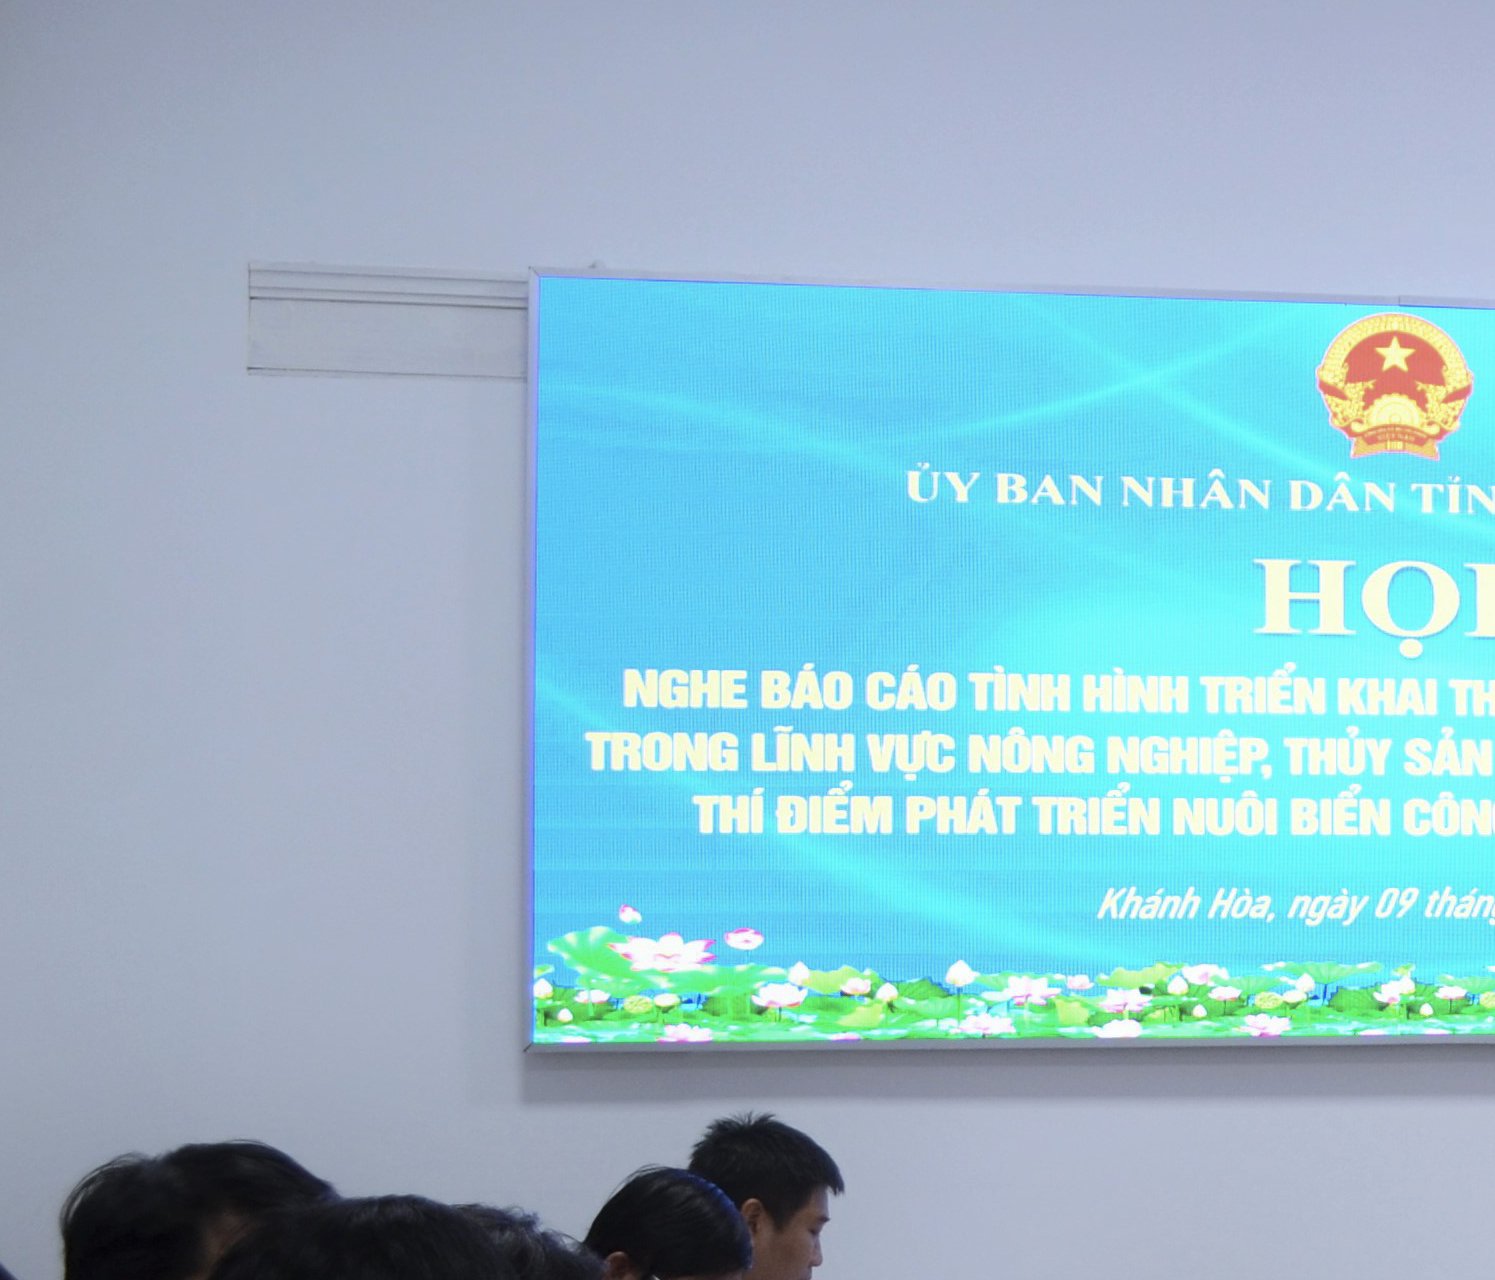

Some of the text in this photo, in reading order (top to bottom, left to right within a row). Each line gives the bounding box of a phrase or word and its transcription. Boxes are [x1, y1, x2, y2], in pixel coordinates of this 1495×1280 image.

[907, 462, 980, 503] ỦY
[996, 473, 1103, 506] BAN
[1121, 468, 1272, 509] NHÂN
[1289, 471, 1396, 513] DÂN
[623, 669, 748, 709] NGHE
[761, 663, 853, 711] BÁO
[865, 664, 957, 711] CÁO
[968, 665, 1071, 712] TÌNH
[1083, 667, 1189, 714] HÌNH
[1199, 663, 1327, 715] TRIỂN
[1337, 677, 1438, 716] KHAI
[585, 731, 739, 771] TRONG
[751, 726, 855, 773] LĨNH
[867, 730, 955, 781] VỰC
[969, 727, 1095, 774] NÔNG
[1107, 729, 1273, 786] NGHIỆP,
[1283, 727, 1392, 776] THỦY
[1403, 727, 1493, 777] SẢN
[692, 787, 764, 834] THÍ
[775, 781, 893, 834] ĐIỂM
[905, 788, 1023, 835] PHÁT
[1031, 783, 1161, 835] TRIỂN
[1173, 789, 1278, 837] NUÔI
[1291, 784, 1391, 836] BIỂN
[1097, 885, 1201, 919] Khánh
[1207, 887, 1275, 923] Hòa,
[1287, 887, 1370, 927] ngày
[1375, 887, 1420, 919] 09
